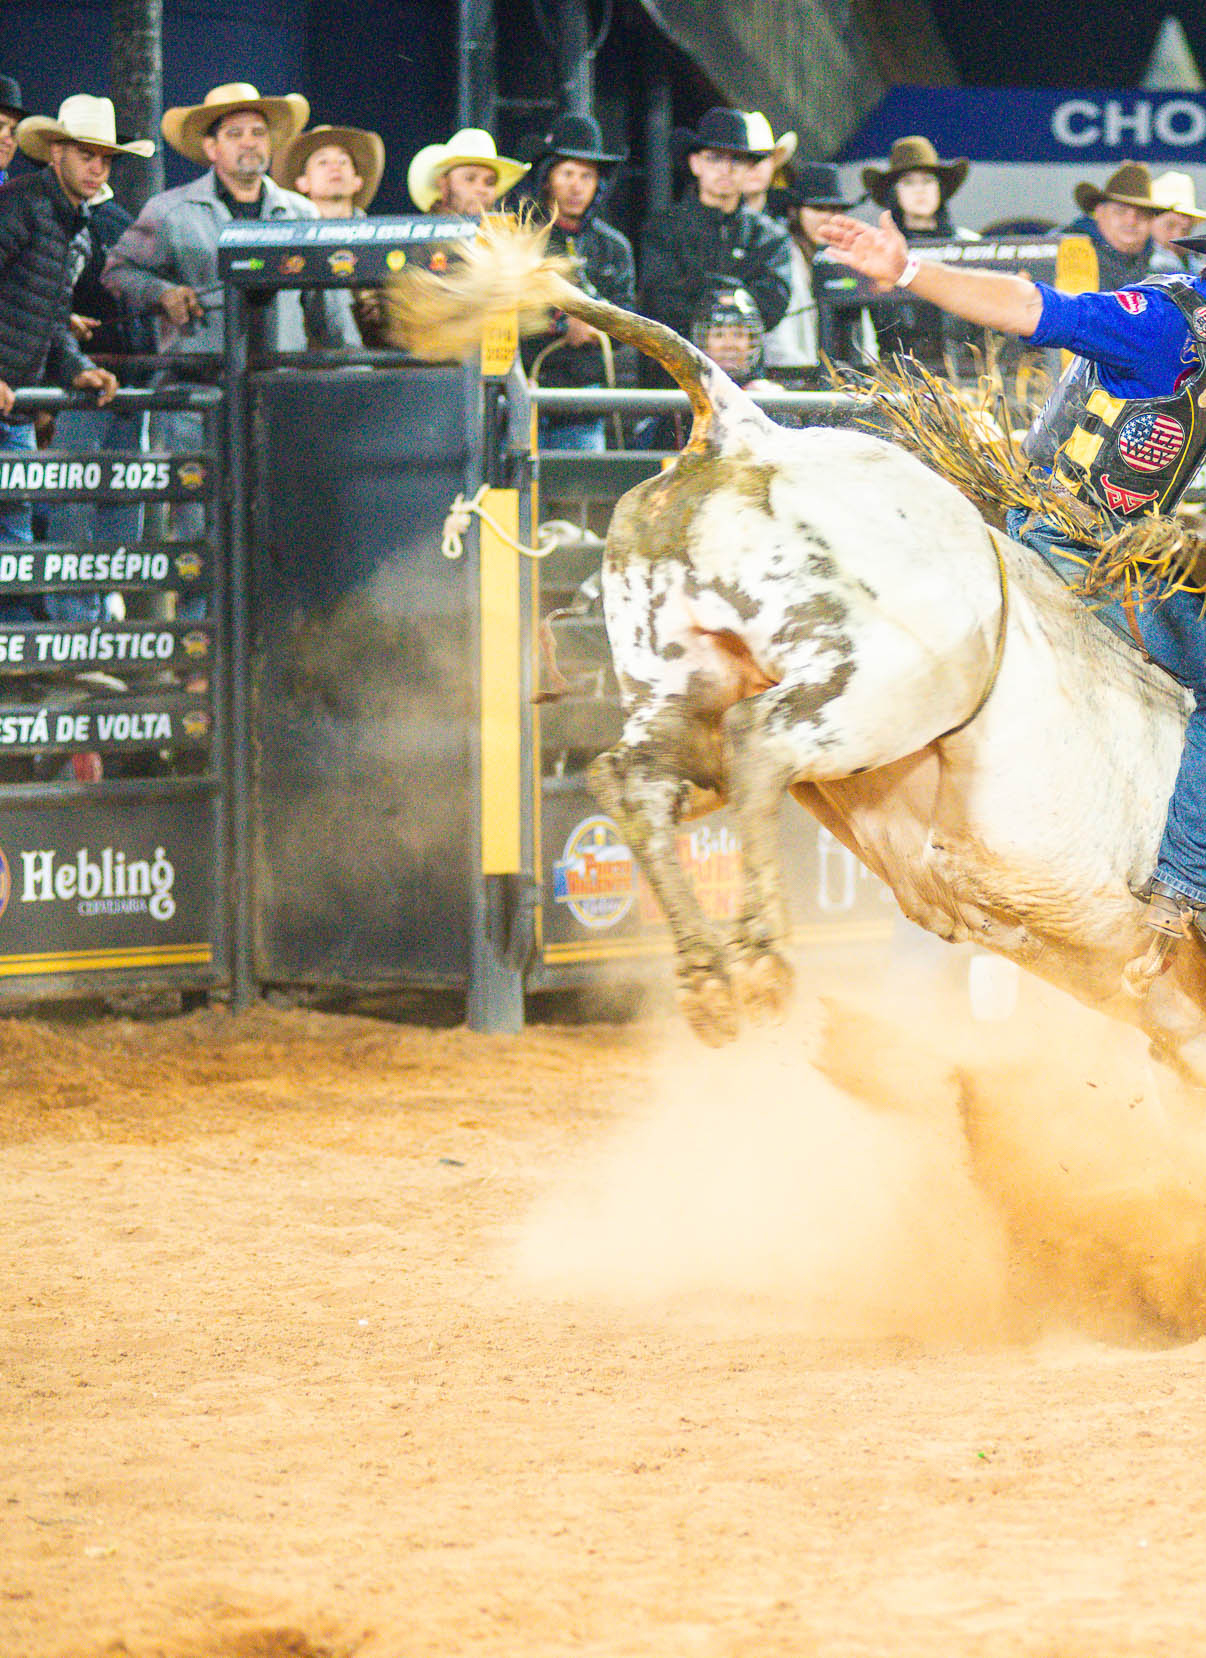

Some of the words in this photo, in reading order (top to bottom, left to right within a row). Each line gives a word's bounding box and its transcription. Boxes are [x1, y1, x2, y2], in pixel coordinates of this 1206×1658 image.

[1135, 418, 1177, 450] BILL
[1126, 438, 1171, 466] WAY
[0, 462, 101, 490] IADEIRO
[109, 462, 171, 490] 2025
[43, 546, 170, 581] PRESÉPIO
[35, 626, 175, 662] TURÍSTICO
[0, 708, 49, 745] STÁ
[56, 715, 91, 743] DE
[97, 712, 173, 742] VOLTA
[20, 846, 177, 921] Hebling
